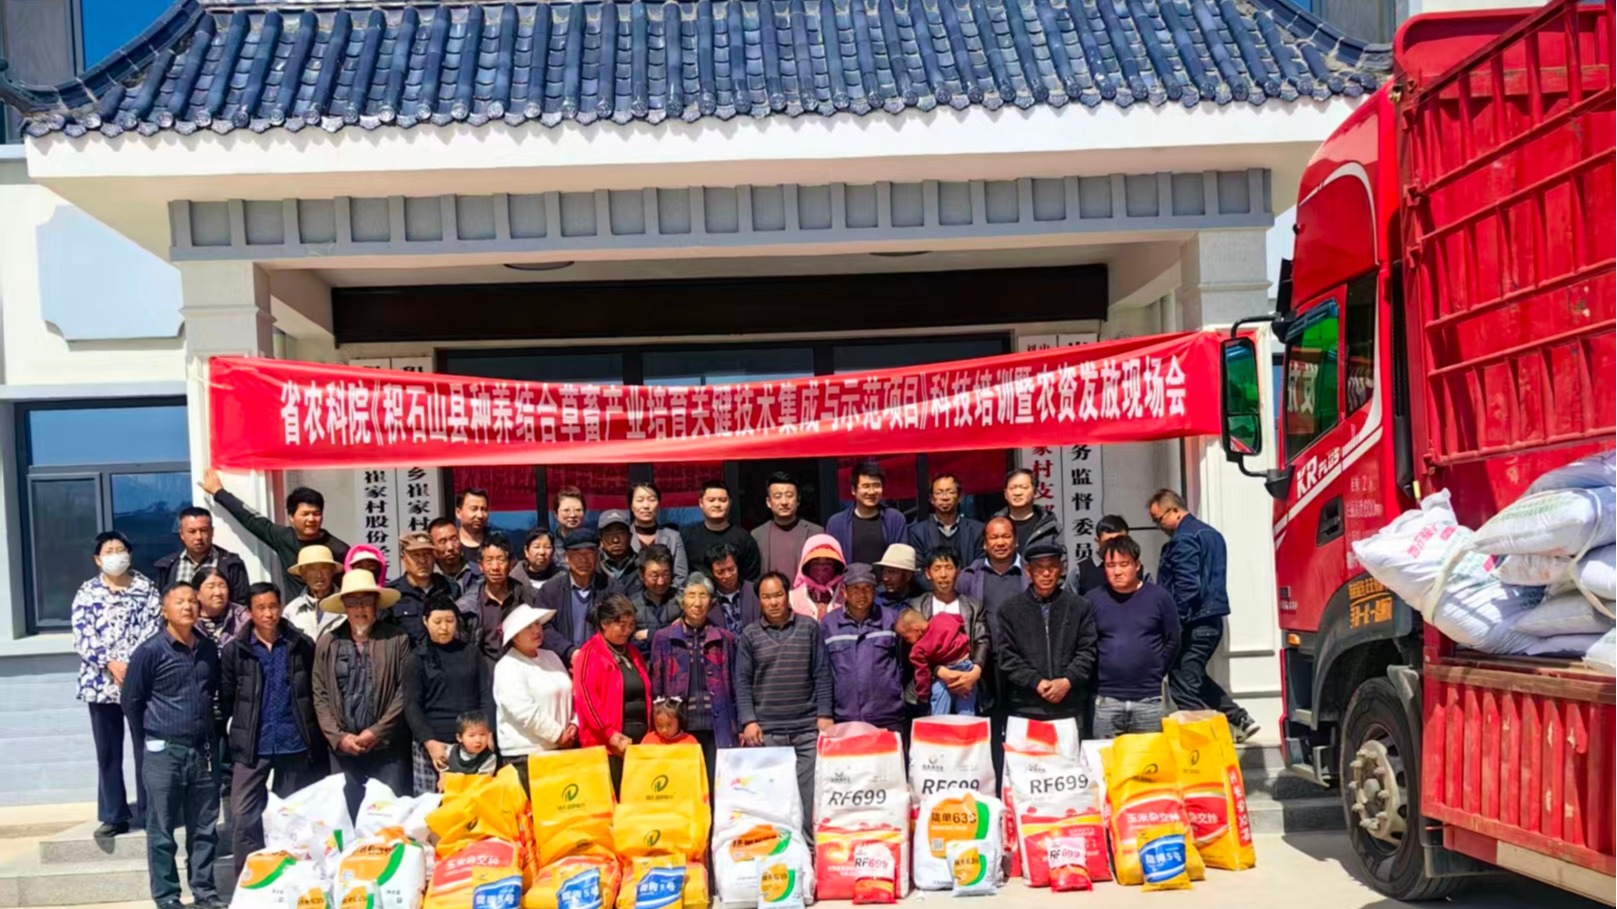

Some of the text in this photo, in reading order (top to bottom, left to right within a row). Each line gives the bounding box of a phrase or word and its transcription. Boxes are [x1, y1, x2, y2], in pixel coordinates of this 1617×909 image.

[281, 354, 1186, 446] 省农科院《积石山县种养结合草畜产业培育关键技术集成与示范项目》科技培训暨农资发放现场会
[1030, 774, 1089, 795] RF699
[828, 788, 888, 806] RF699
[854, 856, 889, 869] RF699
